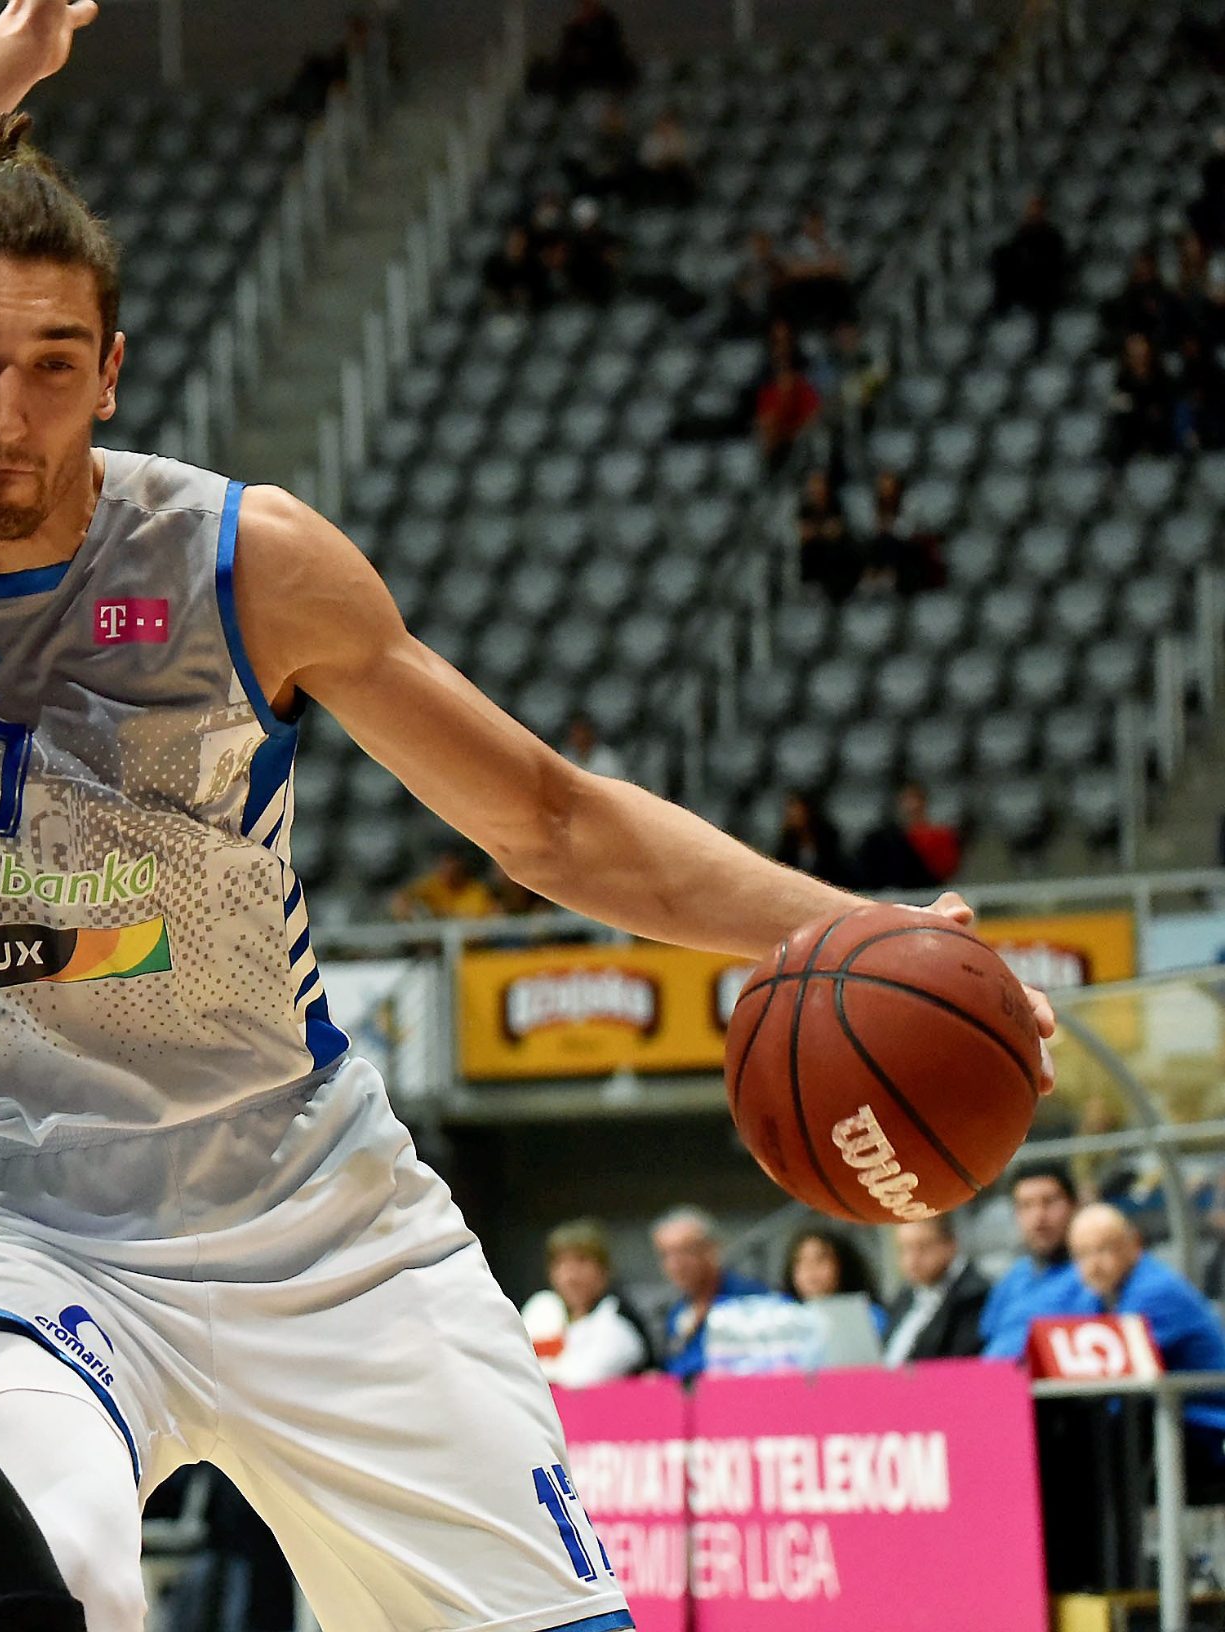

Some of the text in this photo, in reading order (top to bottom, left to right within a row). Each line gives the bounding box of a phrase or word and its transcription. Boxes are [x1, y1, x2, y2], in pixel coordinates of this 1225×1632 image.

[34, 1315, 114, 1387] cromaris
[754, 1432, 950, 1514] TELEKOM
[745, 1521, 842, 1601] LIGA
